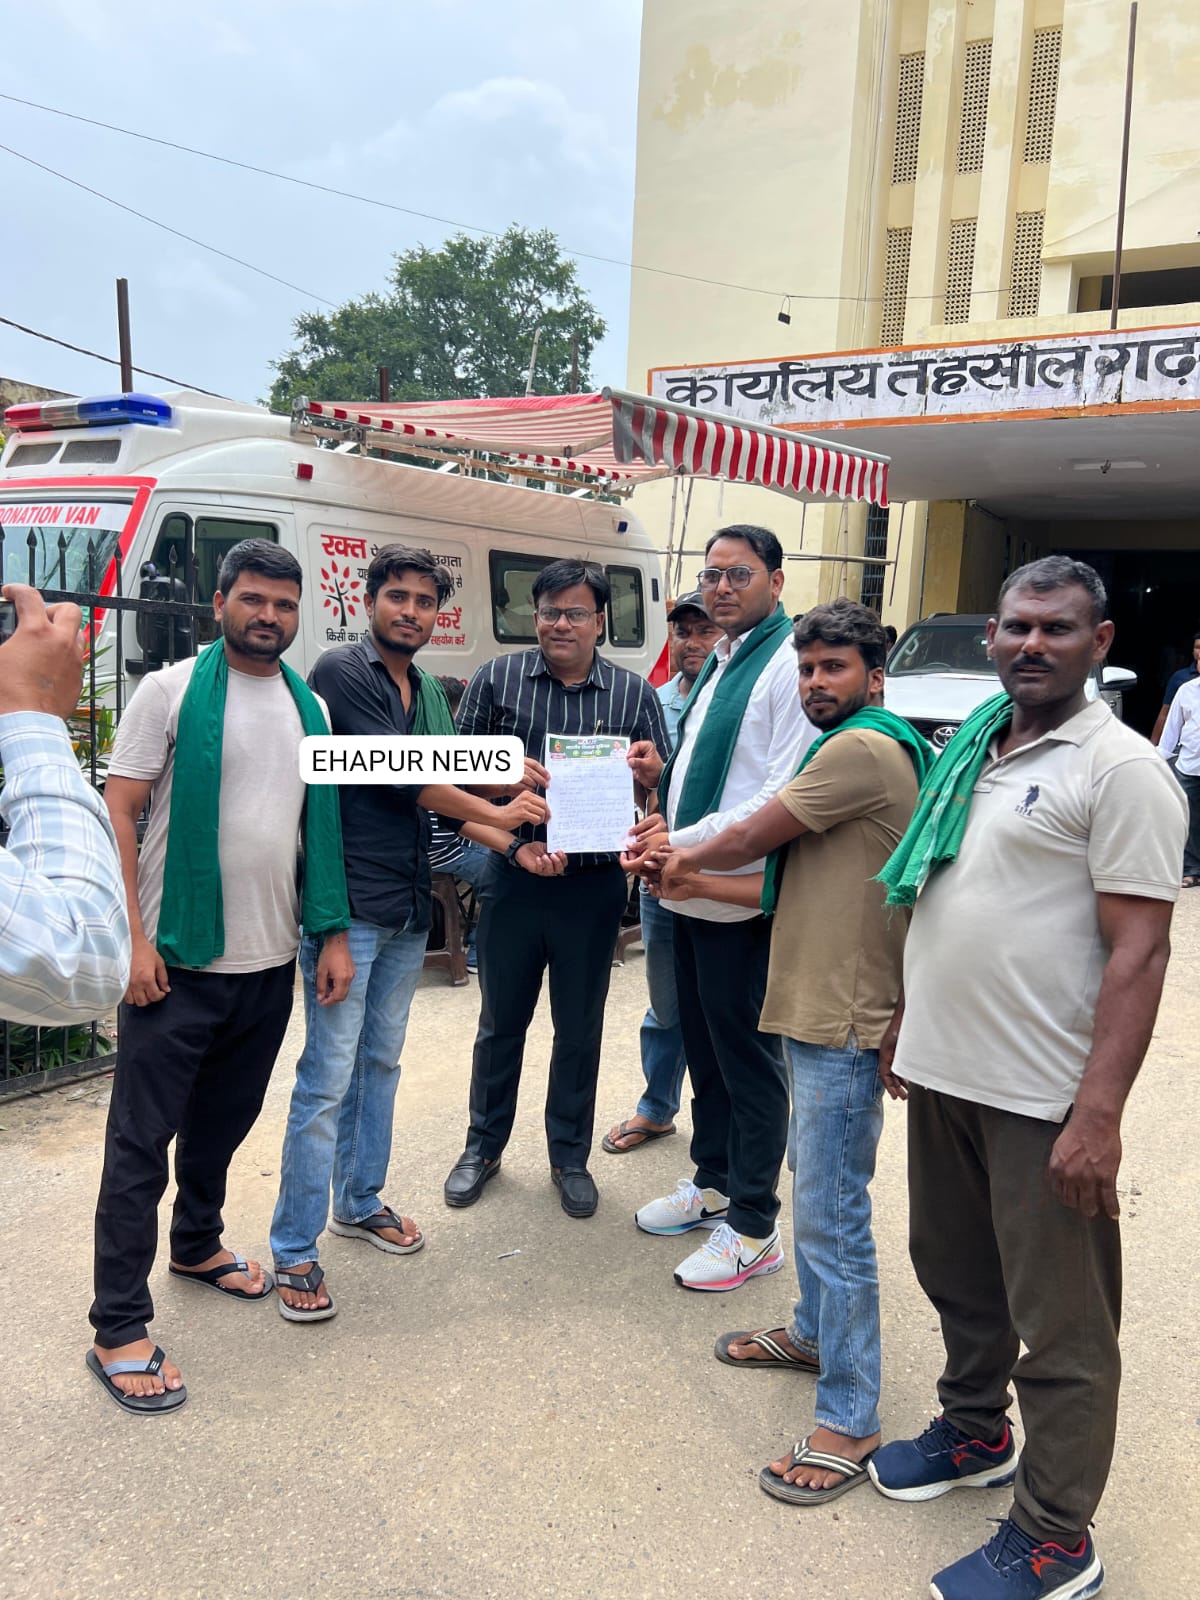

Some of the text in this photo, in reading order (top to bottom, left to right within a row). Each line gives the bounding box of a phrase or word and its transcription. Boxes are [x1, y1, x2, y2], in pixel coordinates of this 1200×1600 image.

[665, 335, 1200, 407] कार्यालय तहसील गढ़
[64, 506, 102, 525] VAN
[320, 533, 367, 560] रक्त
[436, 606, 462, 630] करें
[326, 627, 346, 642] किसी
[347, 632, 359, 642] का
